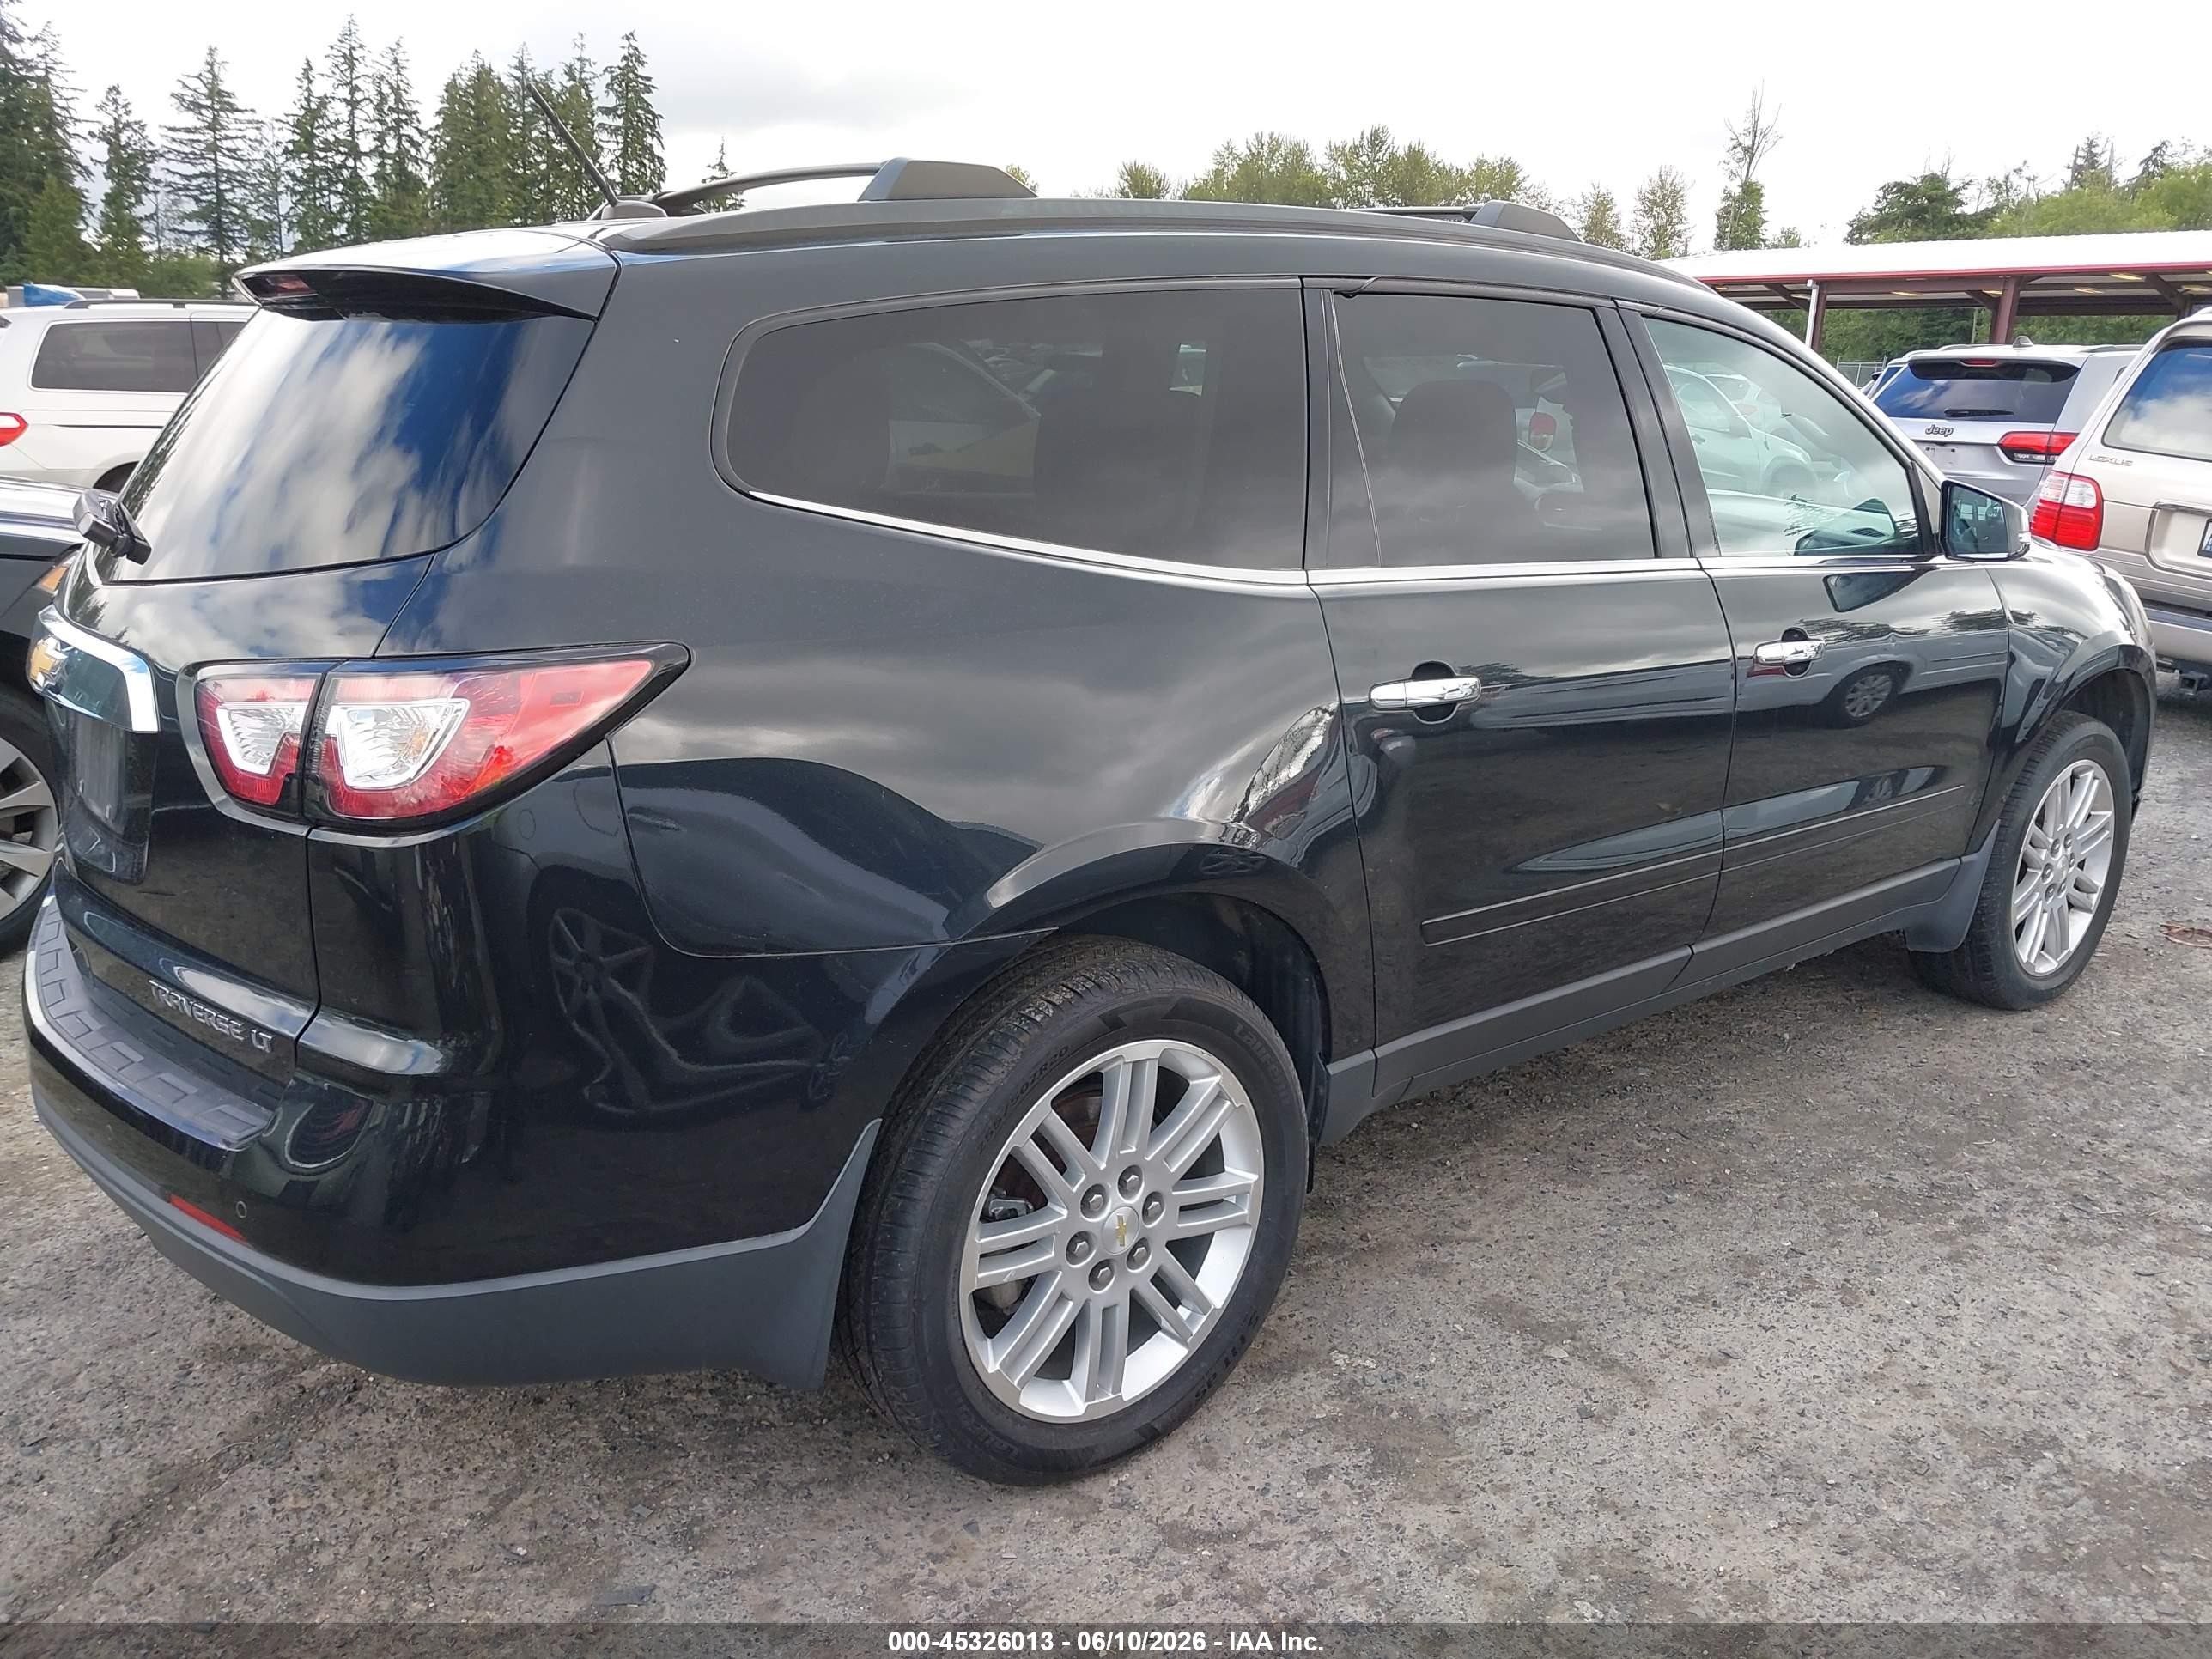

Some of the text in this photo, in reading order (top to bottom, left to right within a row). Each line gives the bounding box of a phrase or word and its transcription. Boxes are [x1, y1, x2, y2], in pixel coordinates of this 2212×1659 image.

[1925, 424, 1954, 437] Jeep
[2087, 454, 2134, 466] LEXUS
[149, 980, 274, 1054] TRAVERSE LT
